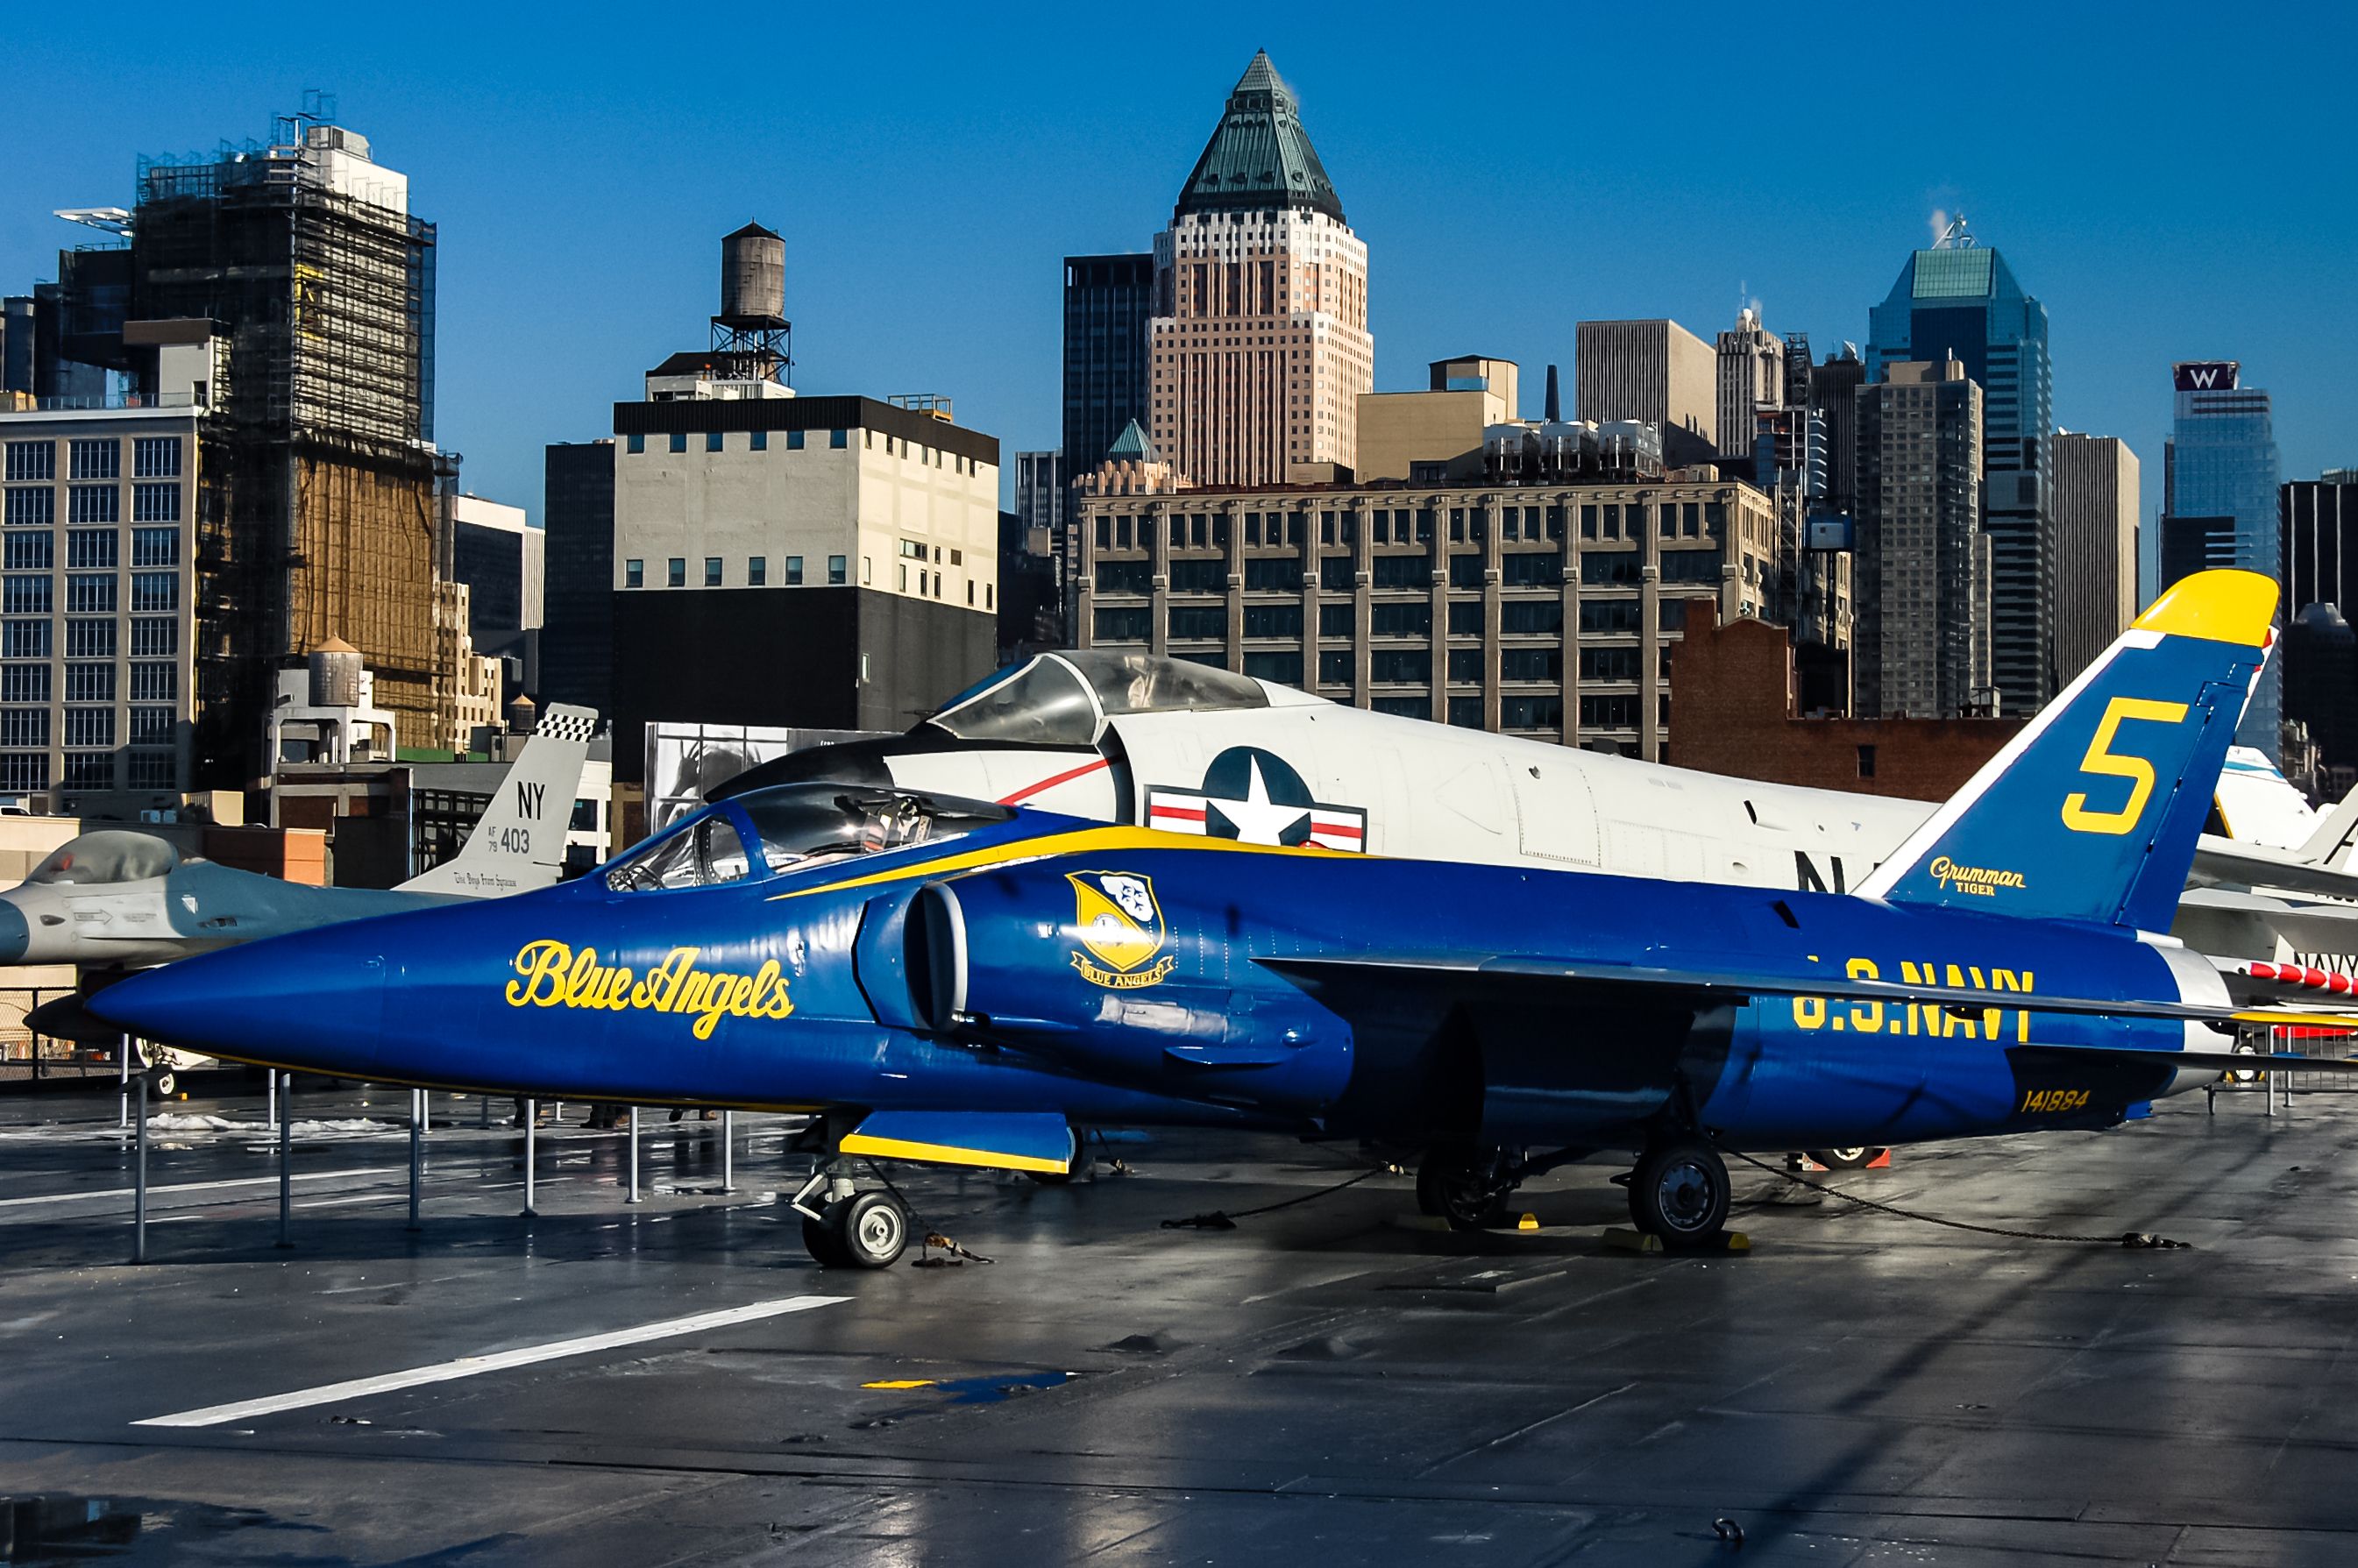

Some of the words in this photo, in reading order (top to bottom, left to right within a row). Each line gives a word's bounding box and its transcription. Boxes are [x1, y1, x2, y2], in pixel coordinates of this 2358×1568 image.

[2190, 369, 2218, 389] W
[2062, 697, 2189, 835] 5
[517, 781, 545, 820] NY
[487, 826, 497, 837] AF
[501, 827, 530, 854] 403
[487, 841, 499, 853] 79
[1929, 855, 2027, 889] Grumman
[1956, 883, 1995, 897] TIGER
[1083, 965, 1112, 986] BLUE
[1114, 968, 1162, 987] ANGELS
[506, 939, 631, 1011] Blue
[630, 947, 795, 1040] Angels
[2021, 1089, 2091, 1113] 141884
